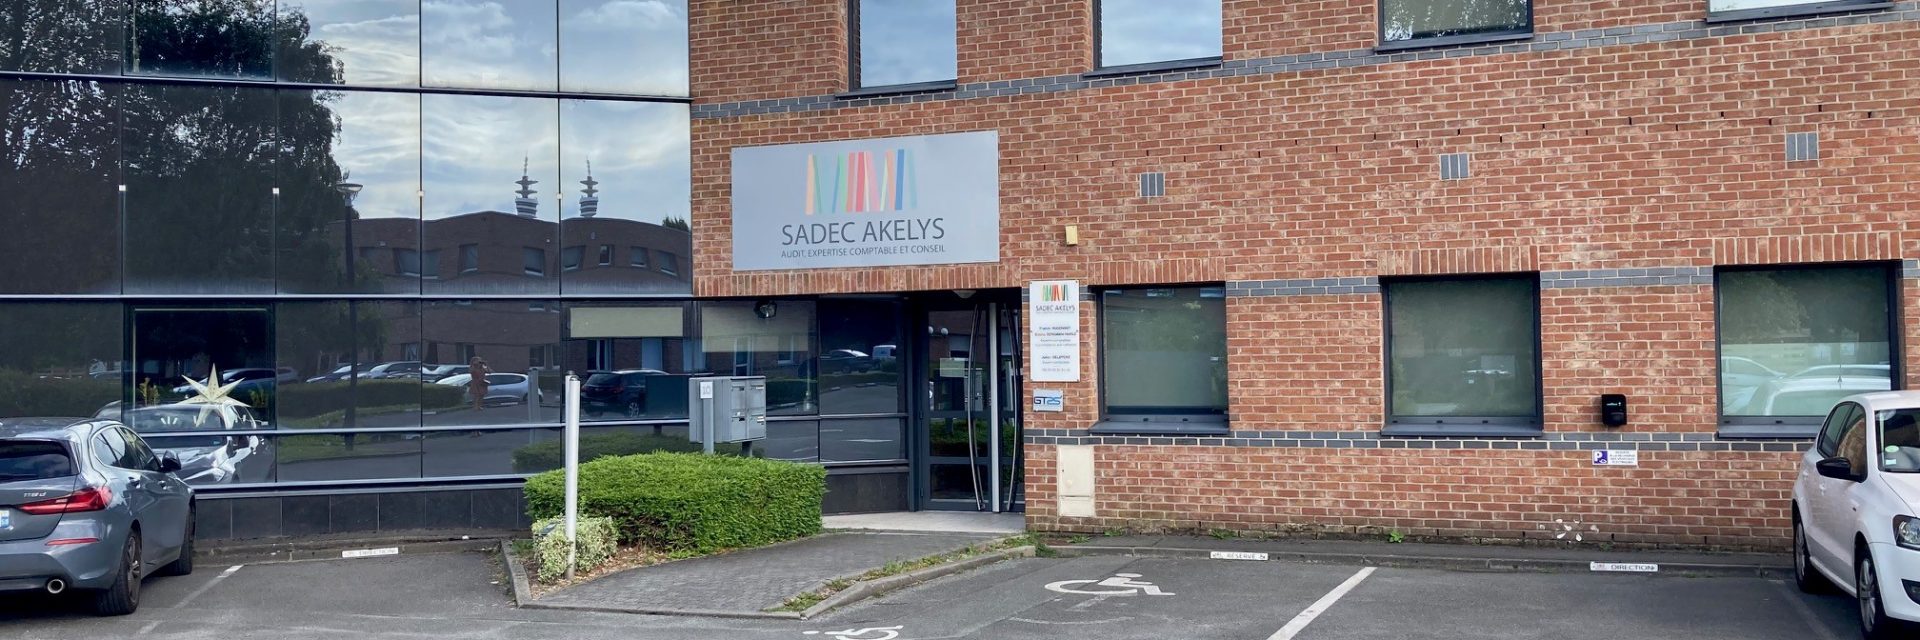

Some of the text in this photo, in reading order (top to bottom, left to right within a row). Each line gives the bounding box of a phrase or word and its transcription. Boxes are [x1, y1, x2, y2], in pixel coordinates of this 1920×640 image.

[781, 217, 945, 246] SADEC AKELYS
[807, 247, 848, 257] EXPERTISE
[849, 245, 898, 256] COMPTABLE
[900, 245, 909, 254] ET
[911, 244, 945, 254] CONSEIL
[1035, 304, 1054, 312] SADEC
[1594, 451, 1603, 462] P
